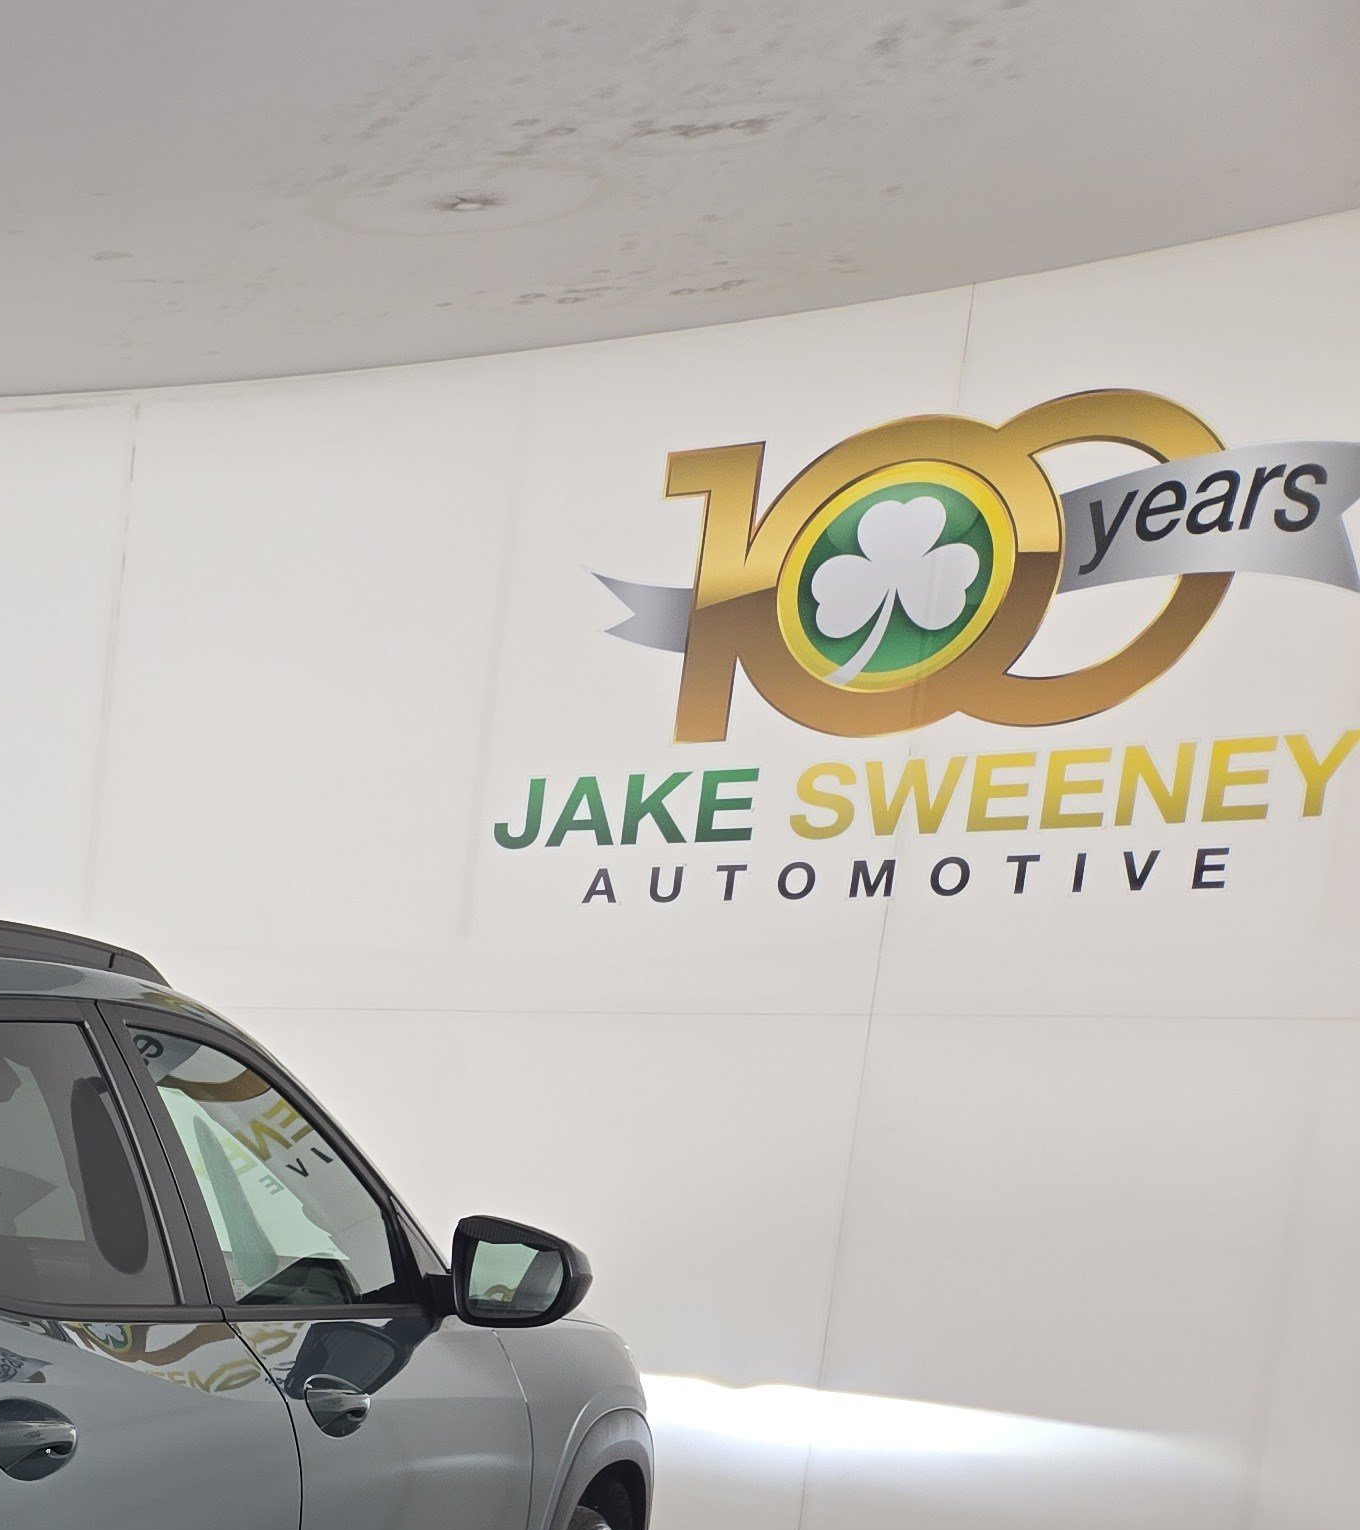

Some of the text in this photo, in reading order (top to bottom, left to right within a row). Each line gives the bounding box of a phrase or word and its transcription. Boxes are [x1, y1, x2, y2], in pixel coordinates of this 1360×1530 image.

[1079, 463, 1327, 575] years
[492, 729, 1360, 850] JAKE SWEENEY
[582, 847, 1232, 906] AUTOMOTIVE
